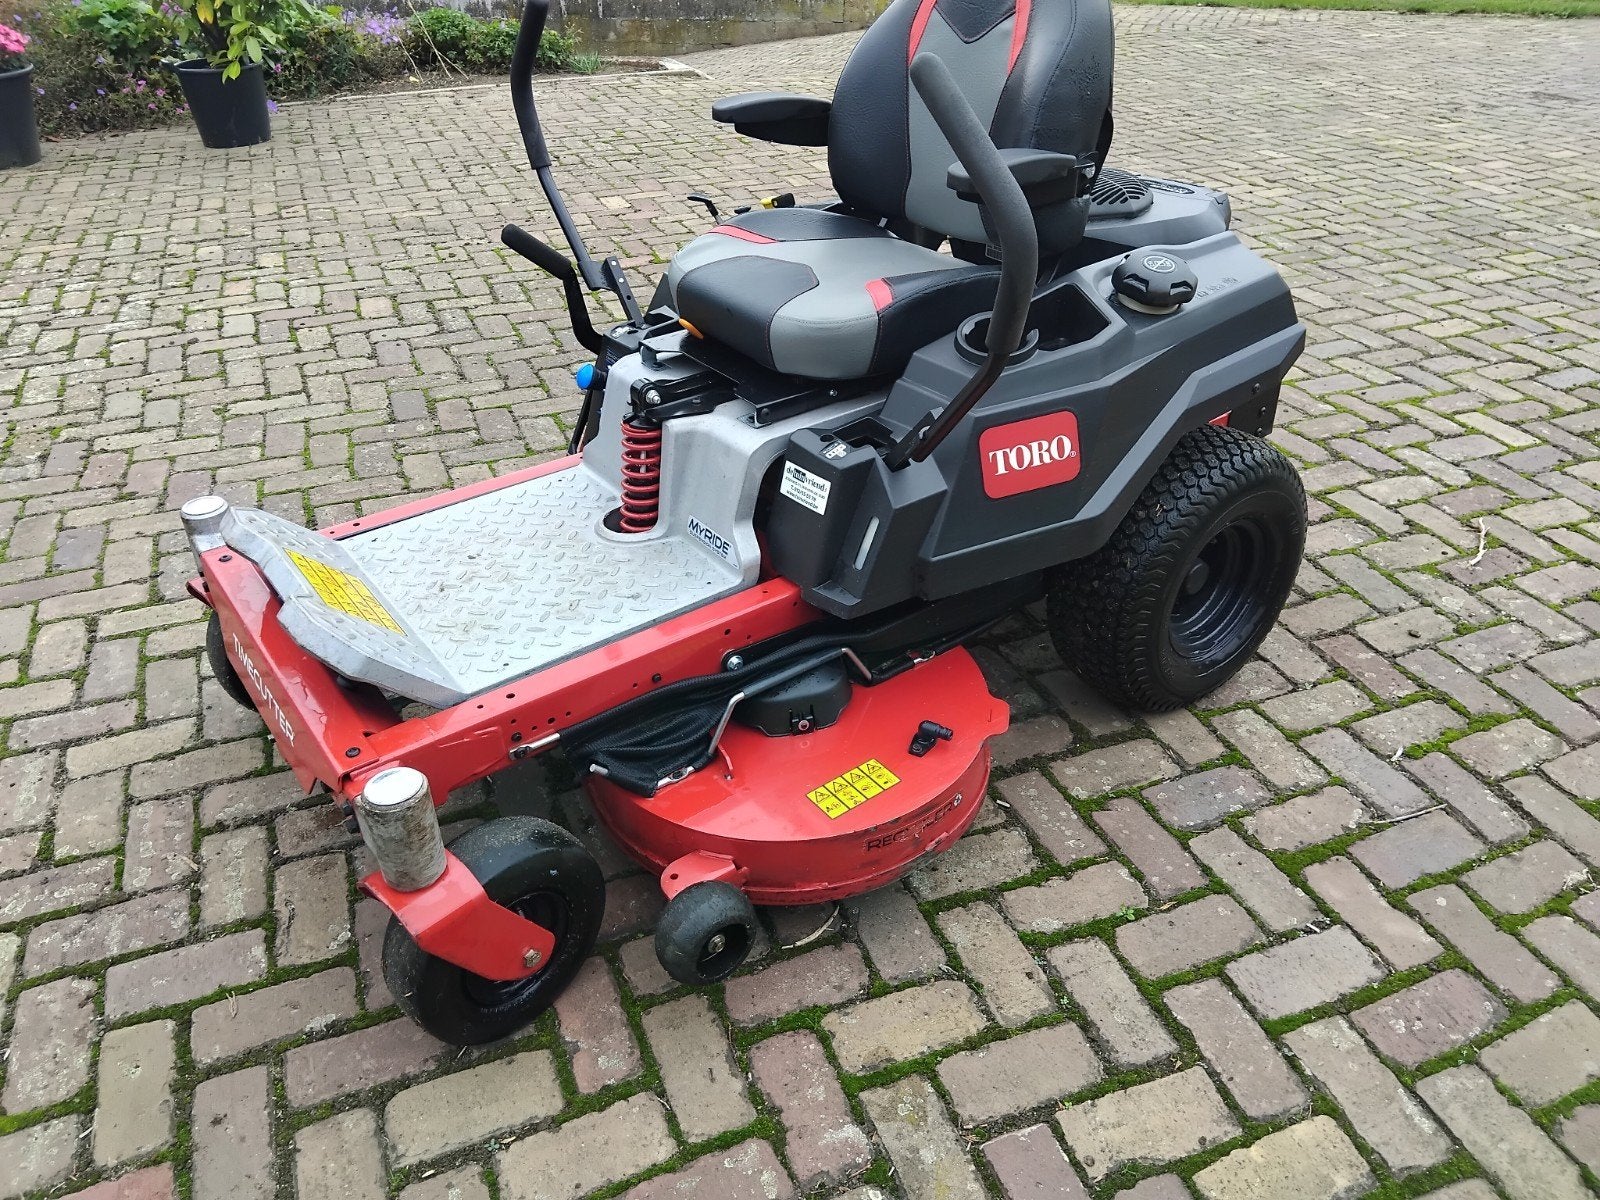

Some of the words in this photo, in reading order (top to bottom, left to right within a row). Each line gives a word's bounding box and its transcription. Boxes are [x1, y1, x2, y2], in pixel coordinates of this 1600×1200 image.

[988, 434, 1072, 476] TORO
[232, 632, 295, 747] TIMECUTTER
[866, 801, 954, 852] RECLER
